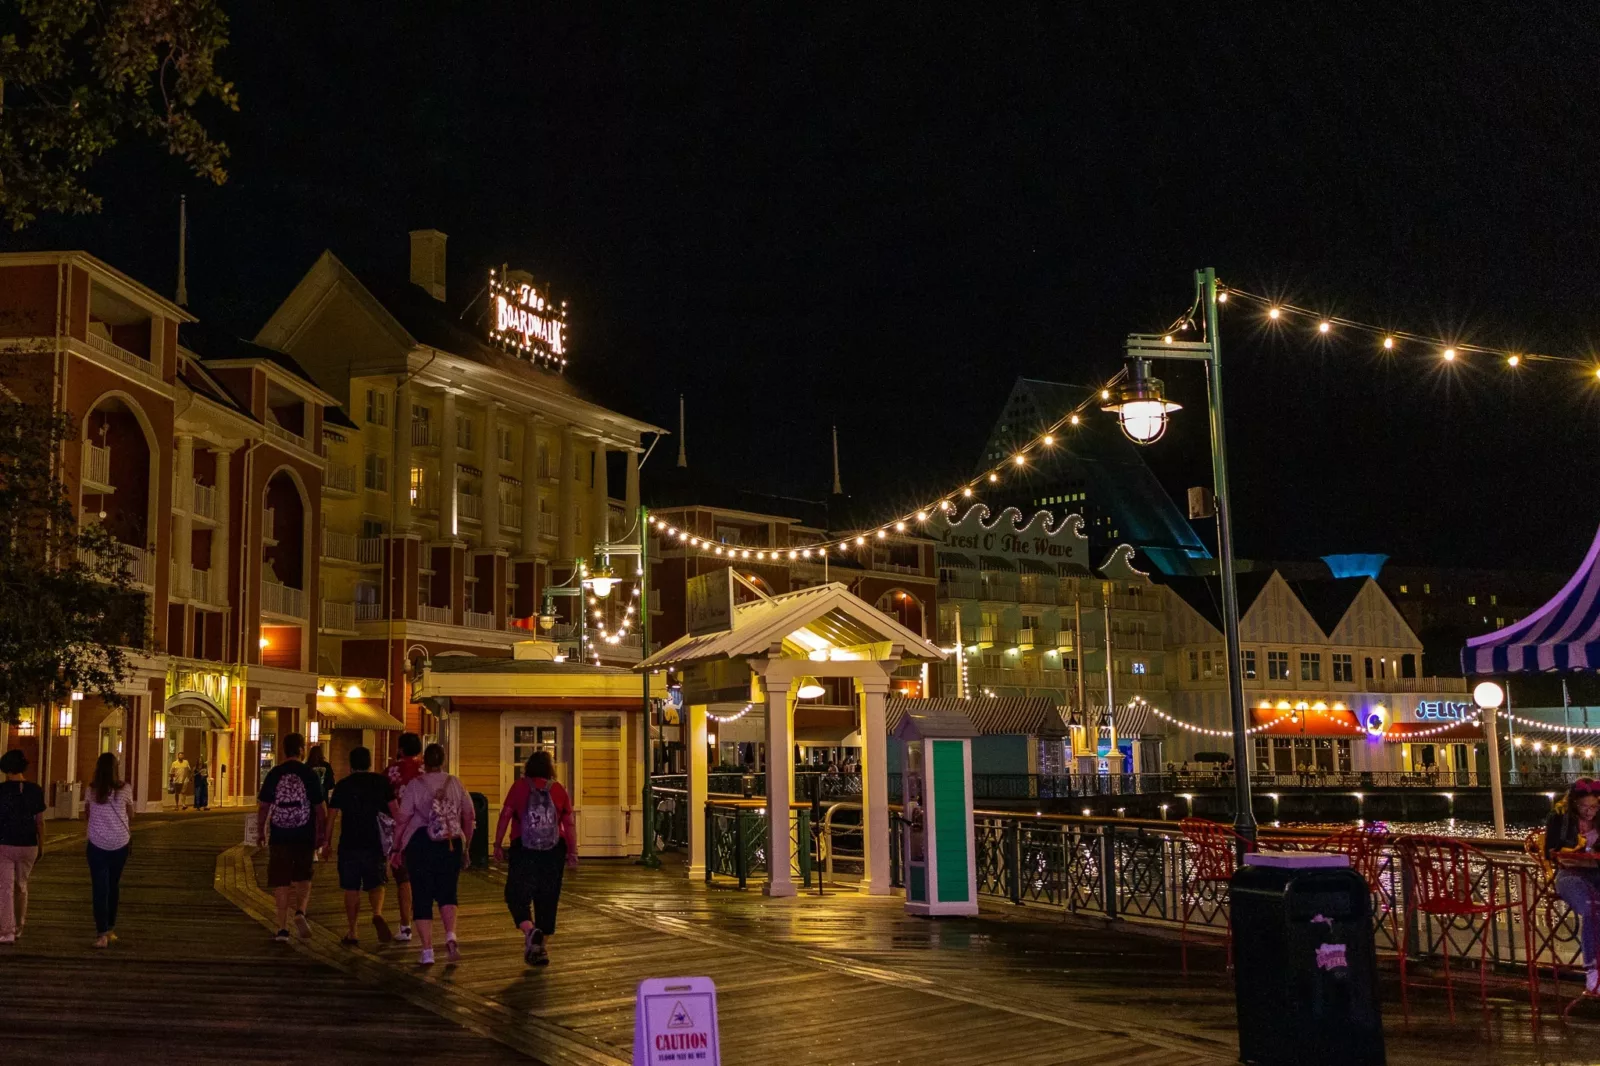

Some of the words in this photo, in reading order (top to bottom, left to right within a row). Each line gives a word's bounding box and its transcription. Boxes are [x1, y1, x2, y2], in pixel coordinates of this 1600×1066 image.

[520, 284, 544, 311] The
[498, 296, 562, 354] BOARDWALK
[1001, 533, 1030, 554] The
[1033, 537, 1073, 558] Wave
[655, 1032, 708, 1051] CAUTION
